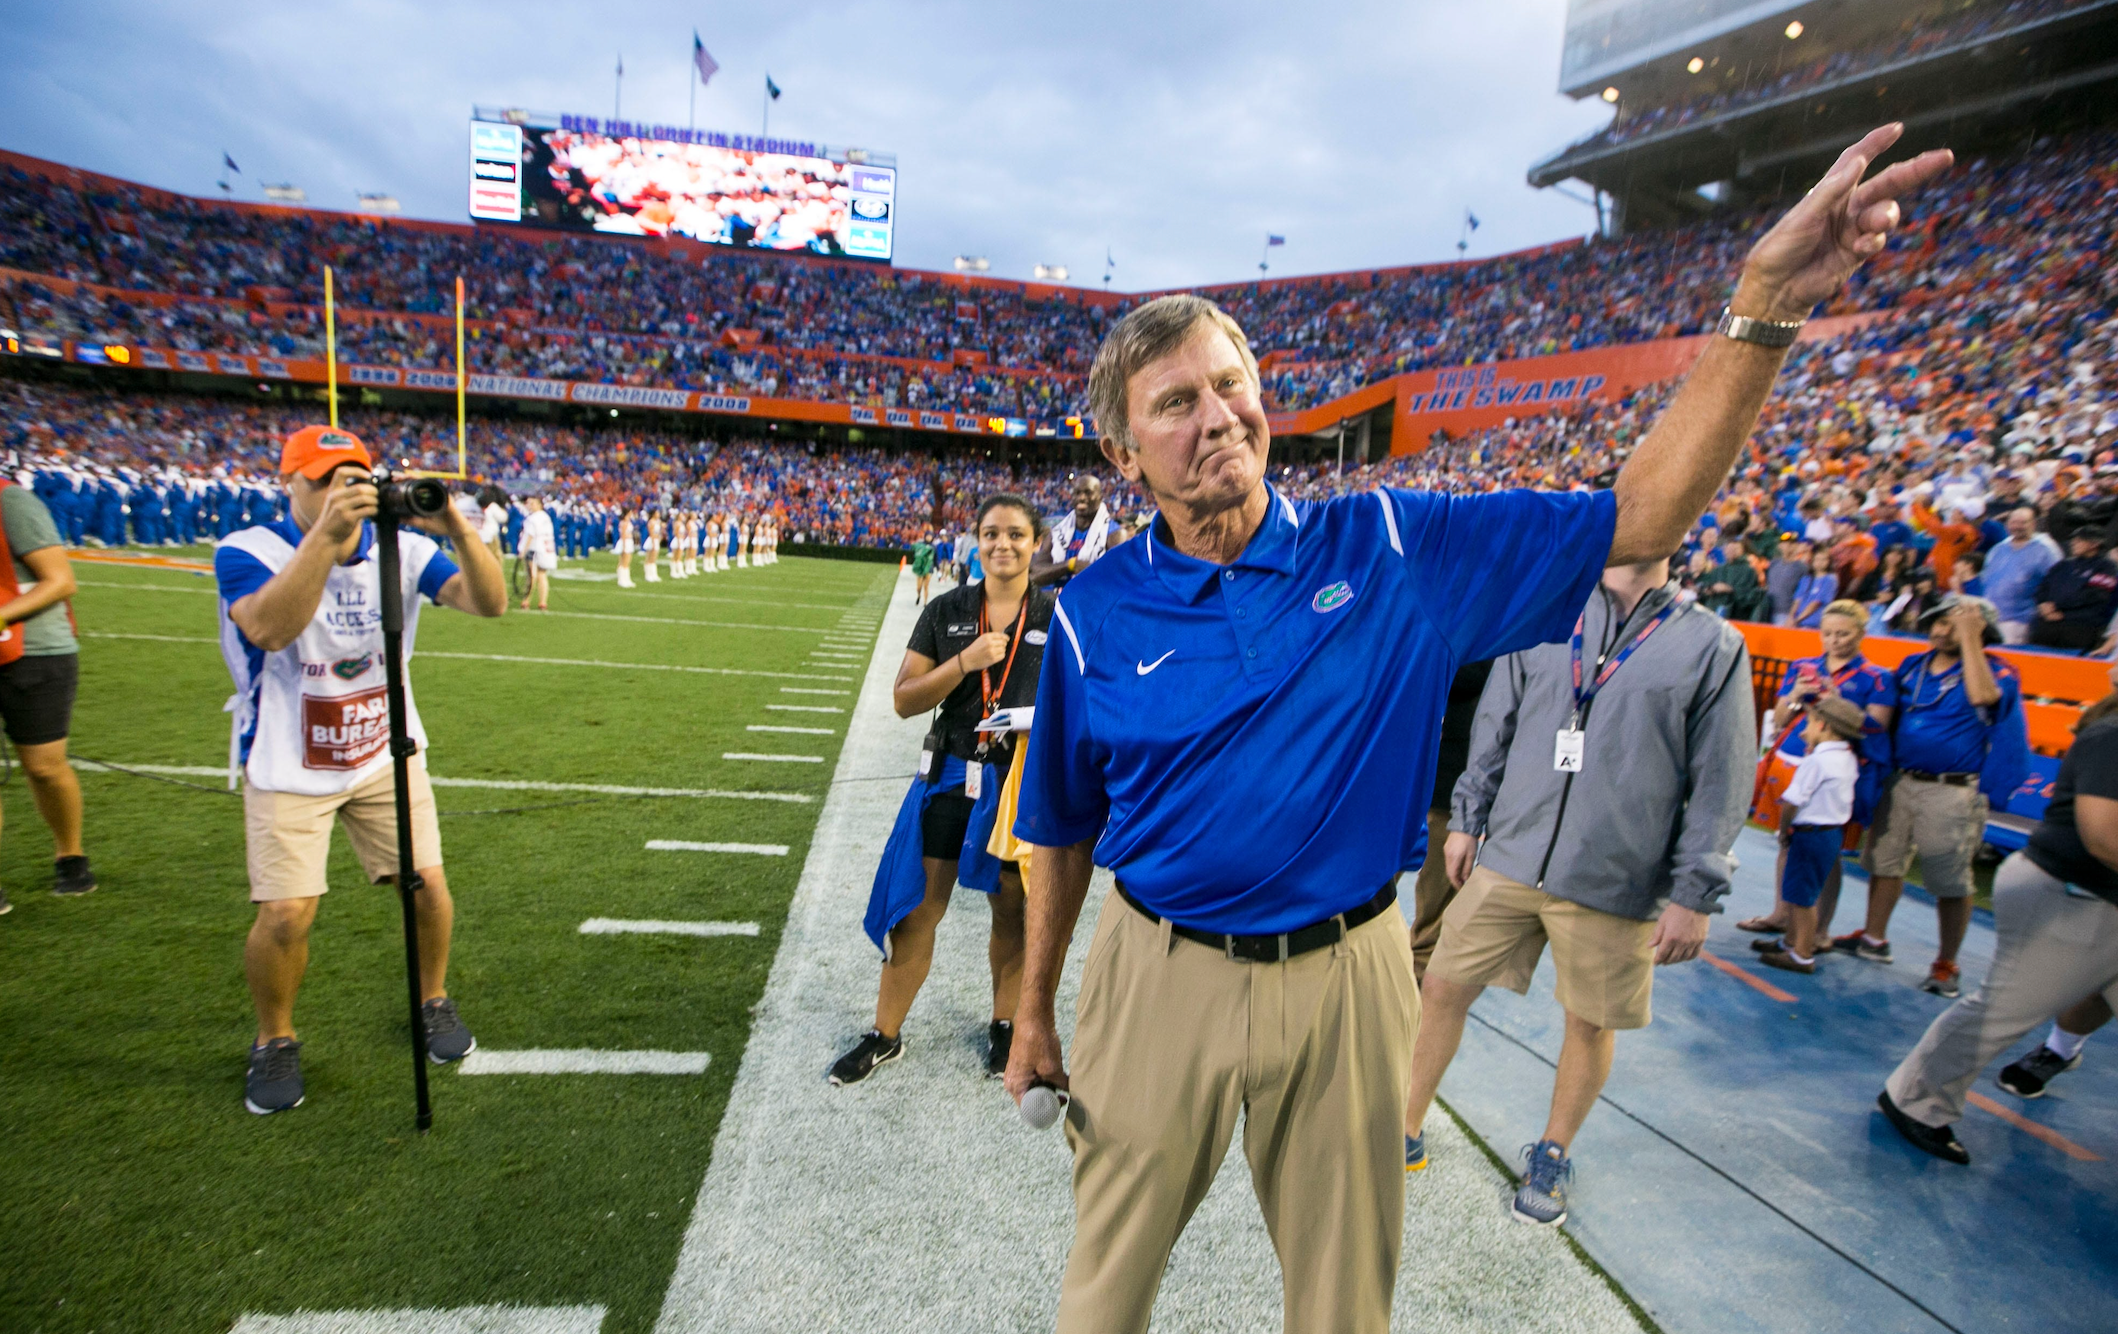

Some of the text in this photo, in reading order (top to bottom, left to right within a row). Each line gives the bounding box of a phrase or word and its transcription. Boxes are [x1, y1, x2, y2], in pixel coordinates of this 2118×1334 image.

[468, 375, 564, 398] NATIONAL
[572, 384, 687, 408] CHAMPIONS
[700, 396, 748, 411] 2008
[1409, 373, 1605, 415] THE SWAMP
[1436, 369, 1476, 391] THIS
[1478, 366, 1498, 388] IS
[312, 716, 390, 745] BUREA
